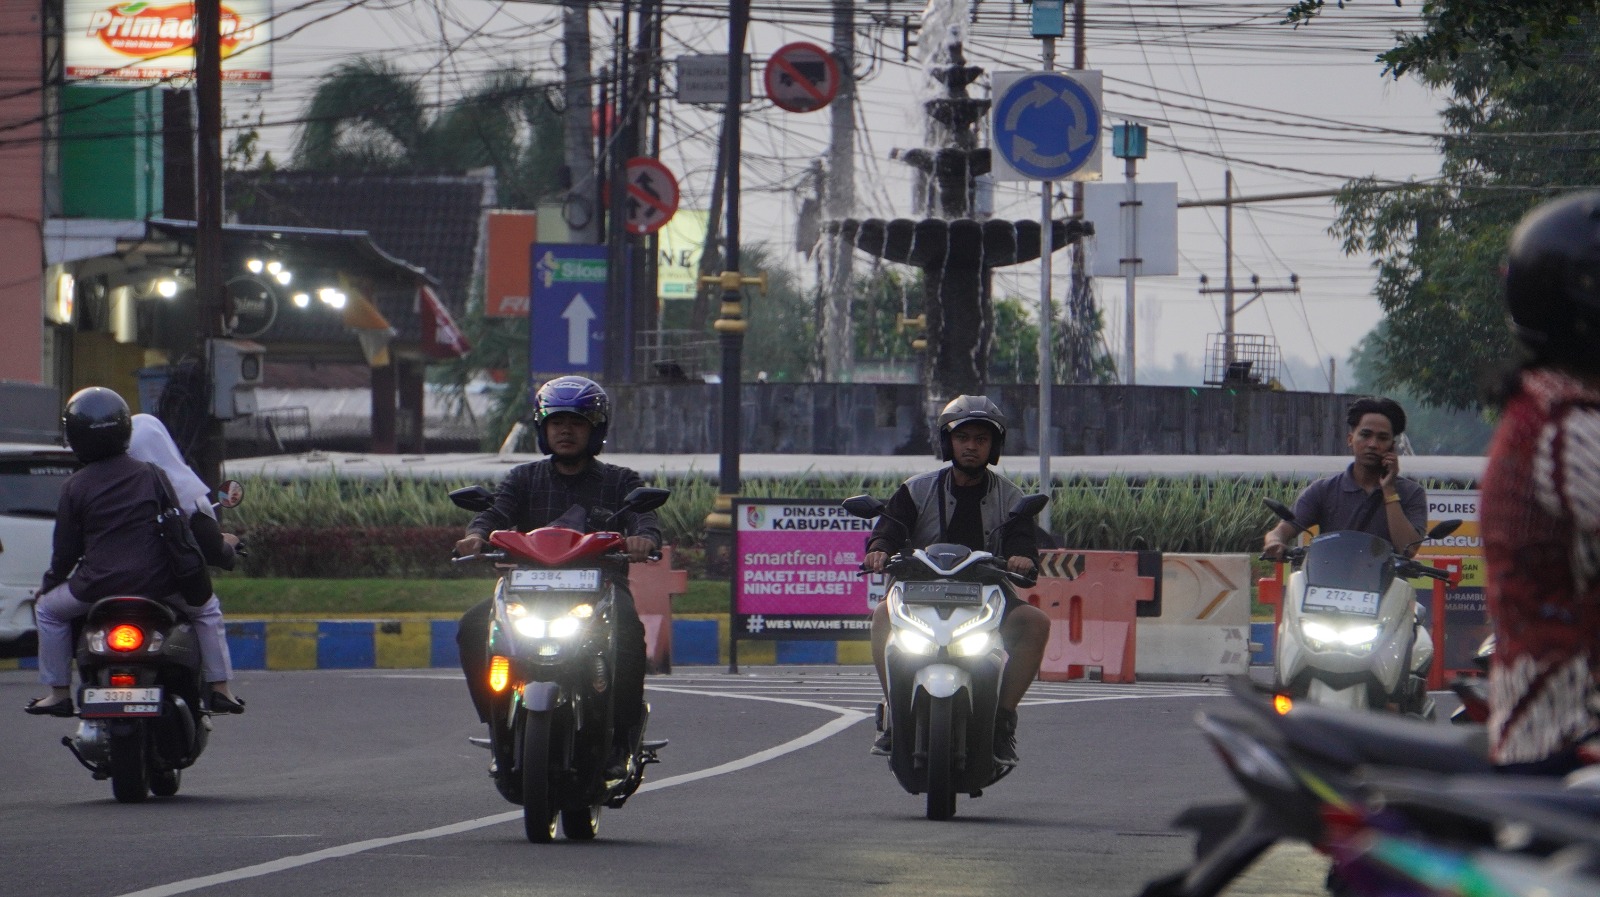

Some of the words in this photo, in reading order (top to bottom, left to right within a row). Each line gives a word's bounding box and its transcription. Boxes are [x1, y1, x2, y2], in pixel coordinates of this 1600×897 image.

[783, 507, 825, 517] DINAS
[1429, 503, 1476, 513] POLRES
[772, 519, 873, 530] KABUPATEN
[744, 550, 827, 565] smartfren
[531, 572, 562, 580] 3384
[744, 570, 795, 582] PAKET
[797, 570, 864, 582] TERBAIK
[744, 583, 782, 594] NING
[784, 583, 844, 594] KELASE
[1309, 588, 1317, 597] P
[1326, 590, 1353, 601] 2724
[792, 620, 842, 630] WAYAHE
[88, 691, 95, 701] P
[104, 691, 133, 701] 3378
[142, 690, 156, 701] JL
